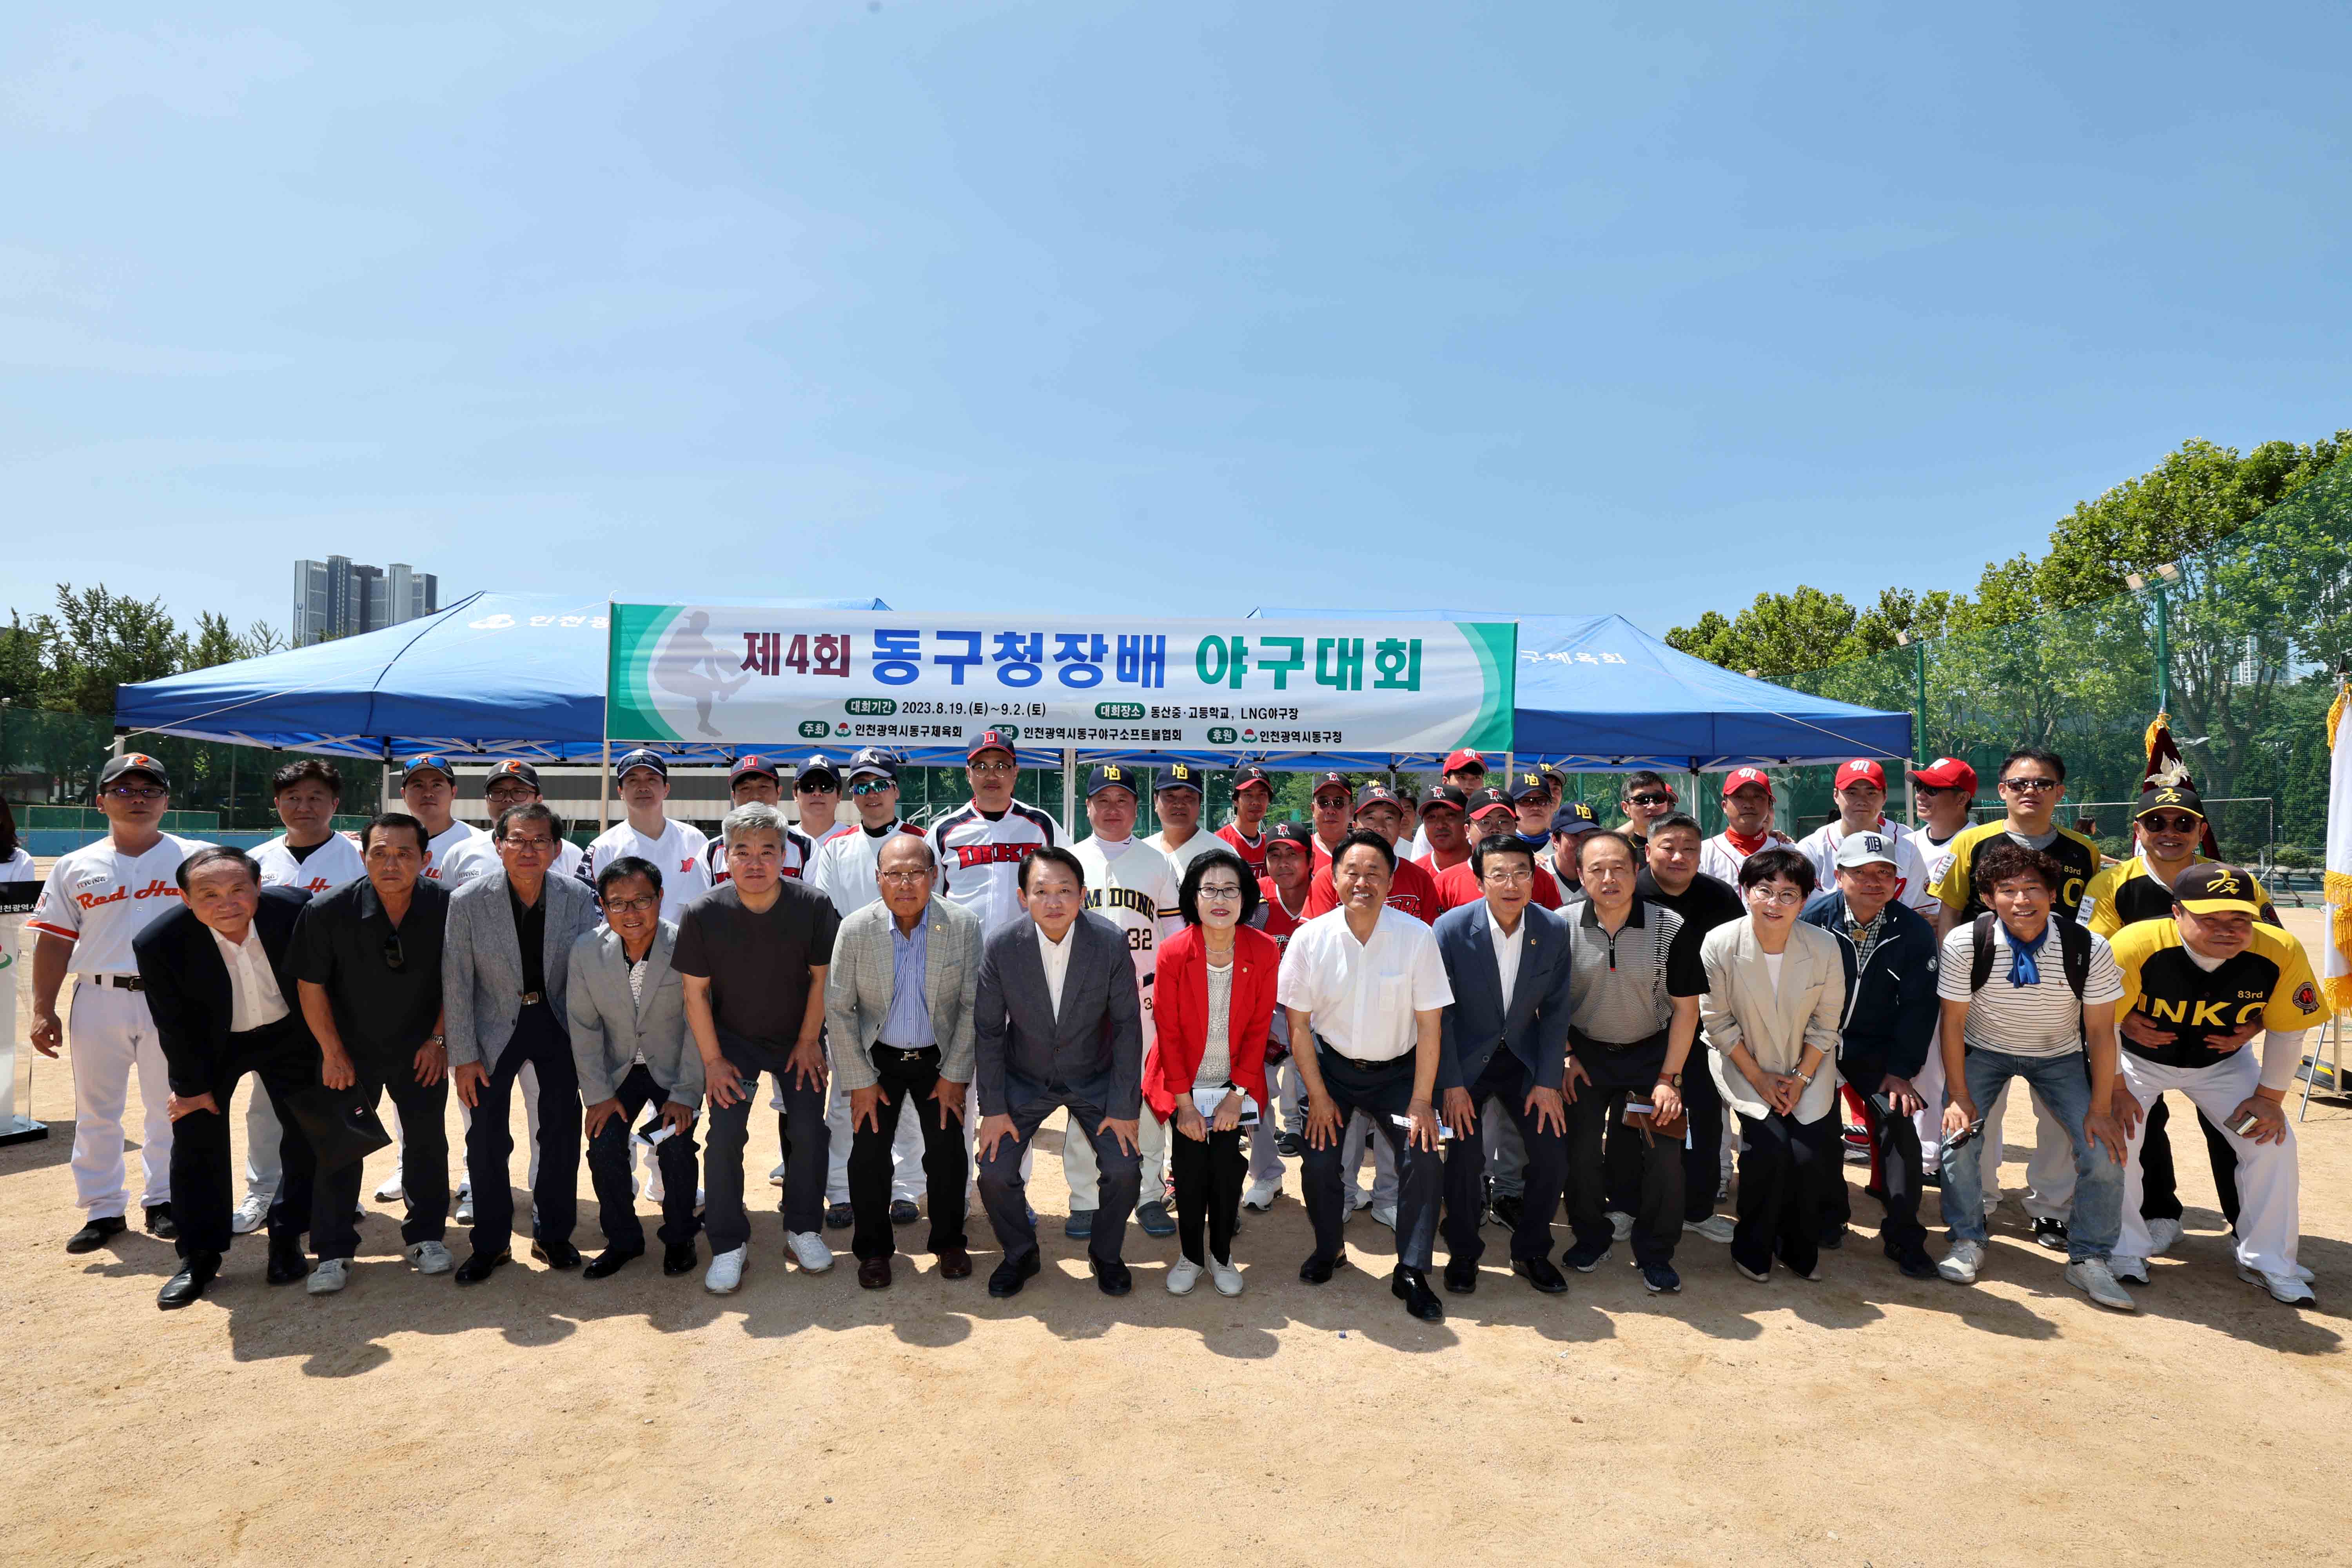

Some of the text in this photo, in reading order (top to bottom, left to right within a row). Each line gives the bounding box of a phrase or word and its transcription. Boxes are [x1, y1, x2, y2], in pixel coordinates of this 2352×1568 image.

[741, 629, 1422, 691] 제4회 동구청장배 야구대회
[851, 700, 892, 714] 대회기간
[1100, 704, 1140, 718] 대회장소
[1241, 708, 1298, 720] LNG야구장
[804, 723, 962, 738] 주최 인천광역시동구체육회
[1024, 727, 1181, 741] 인천광역시동구야구소프트볼협회
[1212, 729, 1342, 743] 후원 인천광역시동구청
[2064, 865, 2081, 875] 83rd
[76, 885, 129, 910] Red
[134, 879, 182, 899] Ha
[1109, 888, 1155, 924] DONG
[1127, 928, 1152, 950] 32
[2237, 991, 2263, 999] 83rd
